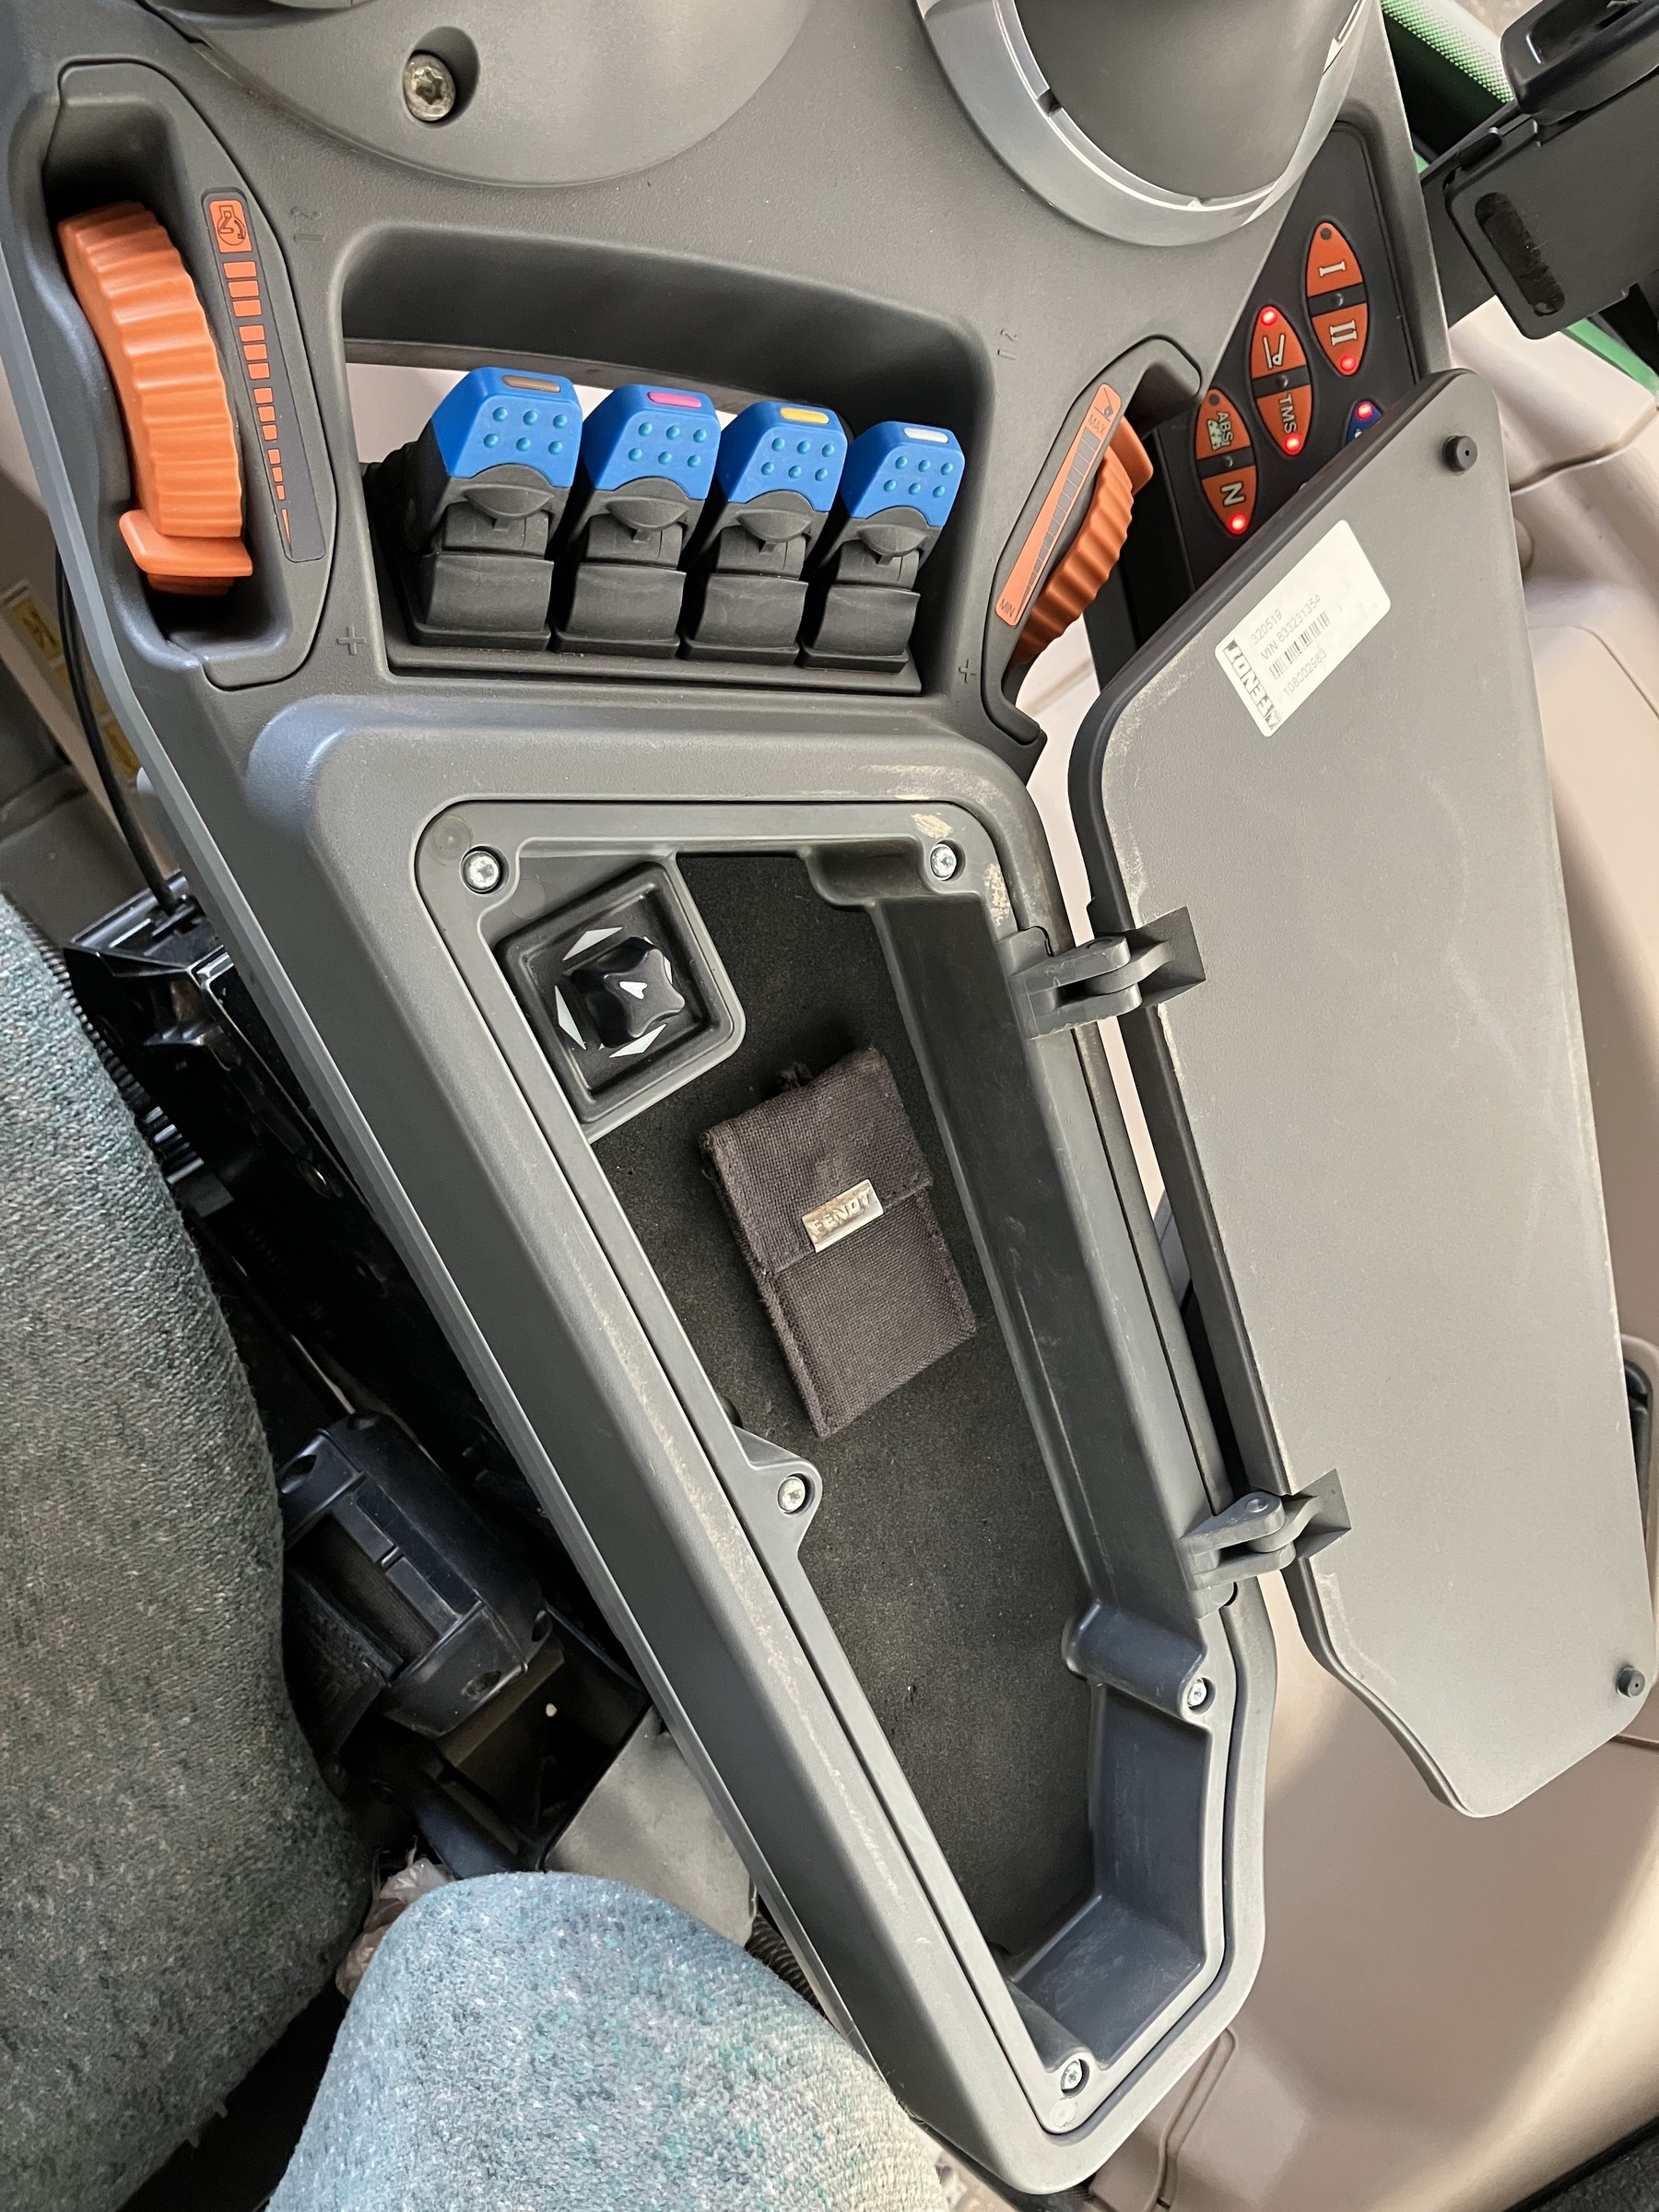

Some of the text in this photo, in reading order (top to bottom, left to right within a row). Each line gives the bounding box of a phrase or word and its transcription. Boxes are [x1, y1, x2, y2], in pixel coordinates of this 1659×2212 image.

[1087, 413, 1106, 436] MAX
[1217, 411, 1233, 443] ABS
[1278, 393, 1297, 436] TMS
[1220, 481, 1245, 506] N
[998, 597, 1015, 618] MIN
[1251, 608, 1283, 645] 320519
[1260, 641, 1279, 661] VIN
[1223, 639, 1275, 718] FENDT
[808, 1186, 872, 1236] FENDT
